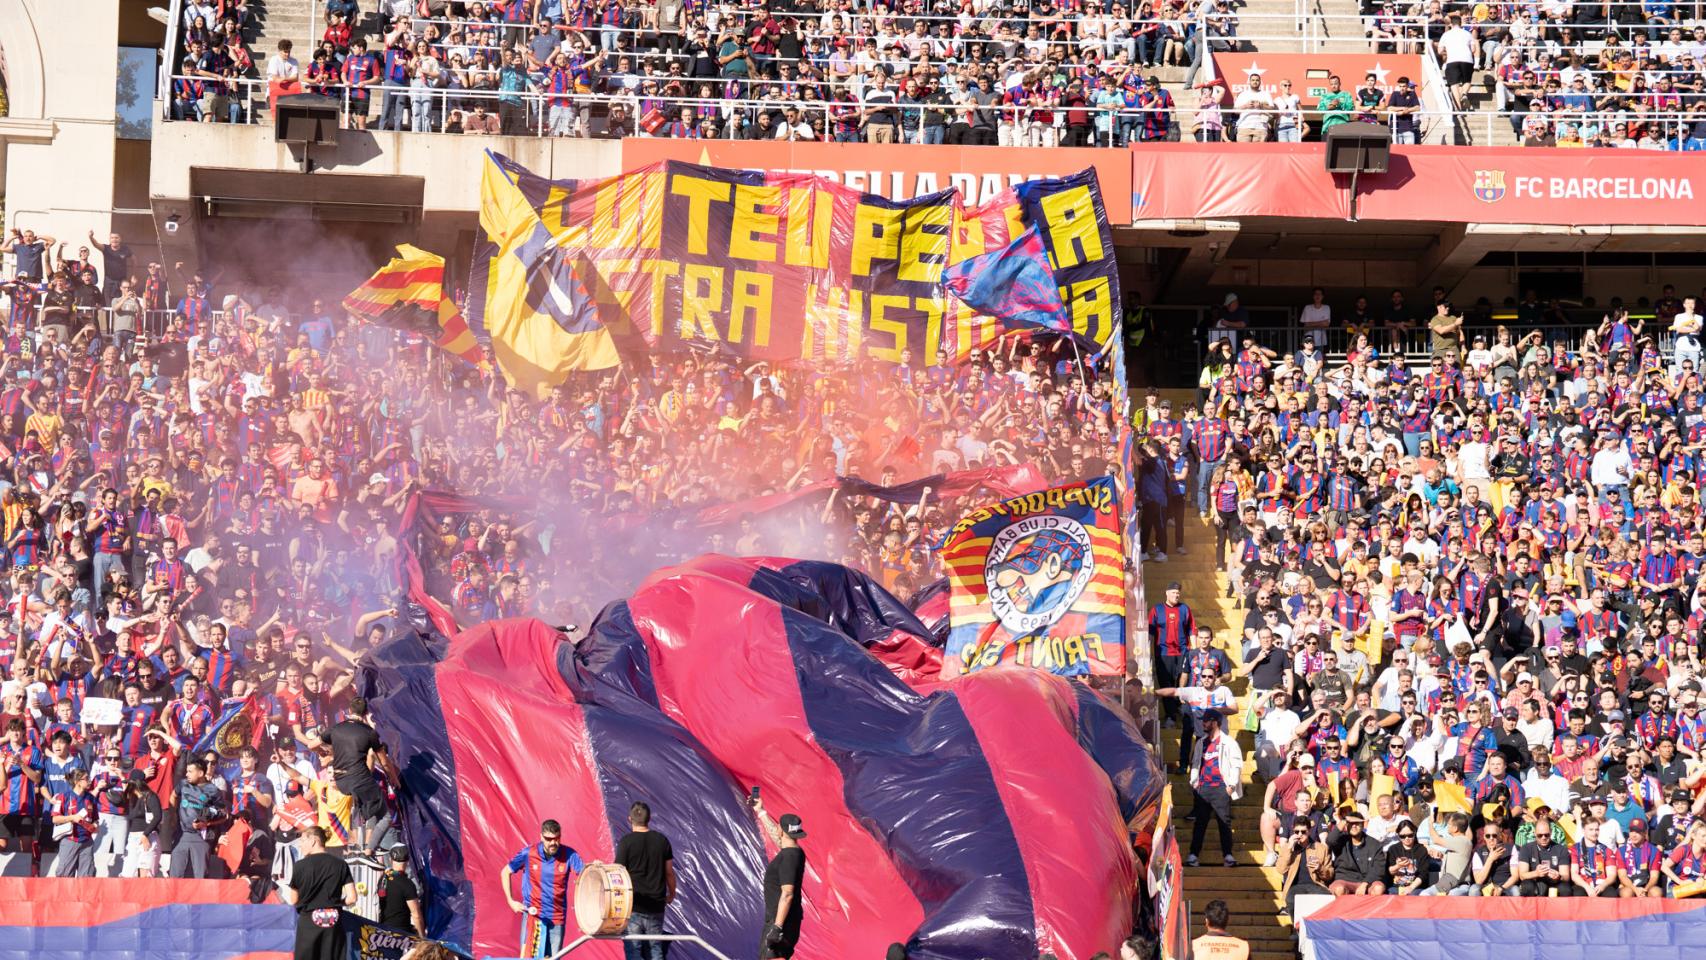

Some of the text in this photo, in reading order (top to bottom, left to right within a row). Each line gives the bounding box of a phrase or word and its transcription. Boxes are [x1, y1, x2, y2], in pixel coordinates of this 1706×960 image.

[1515, 177, 1693, 200] FC BARCELONA
[487, 170, 834, 269] LUITEU
